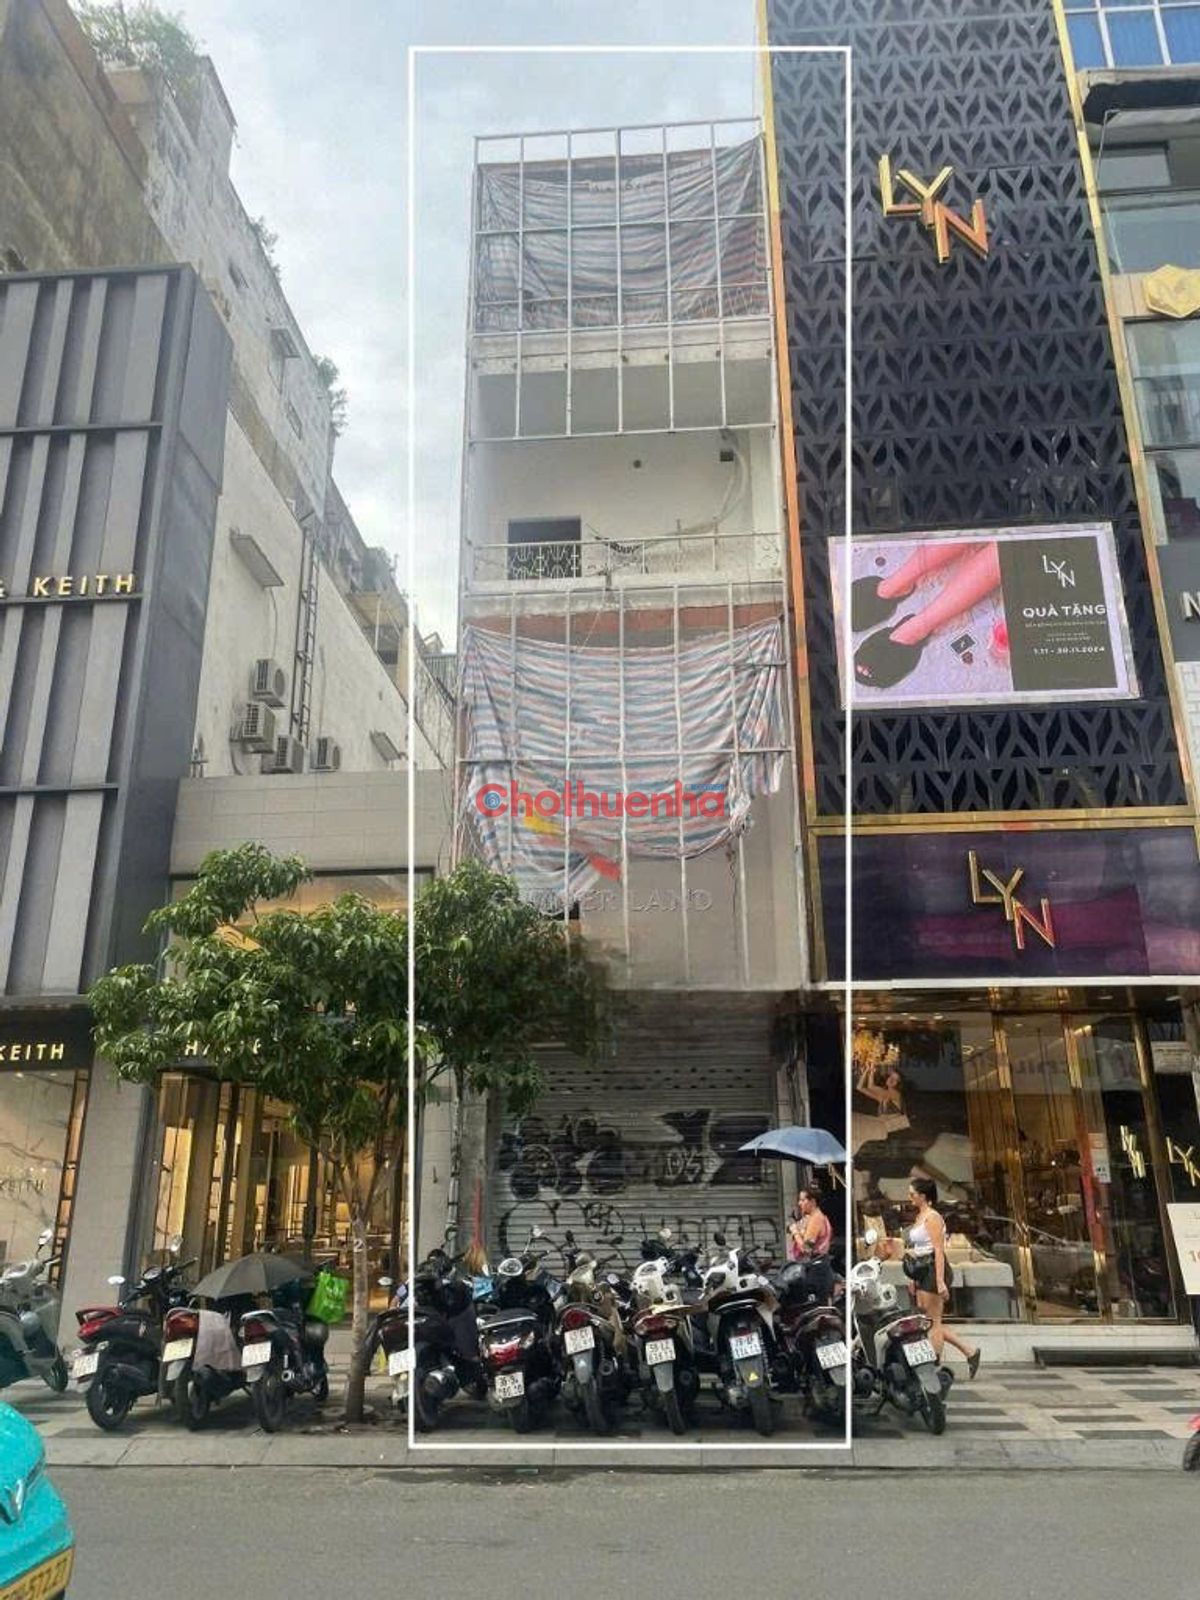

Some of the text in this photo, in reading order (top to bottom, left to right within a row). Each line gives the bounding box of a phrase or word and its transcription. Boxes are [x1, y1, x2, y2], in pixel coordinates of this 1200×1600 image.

[879, 154, 989, 264] LYN
[33, 573, 134, 597] KEITH
[1042, 554, 1076, 588] LYN
[1022, 603, 1059, 618] QUÀ
[968, 850, 1056, 950] LYN
[0, 1043, 64, 1060] KEITH
